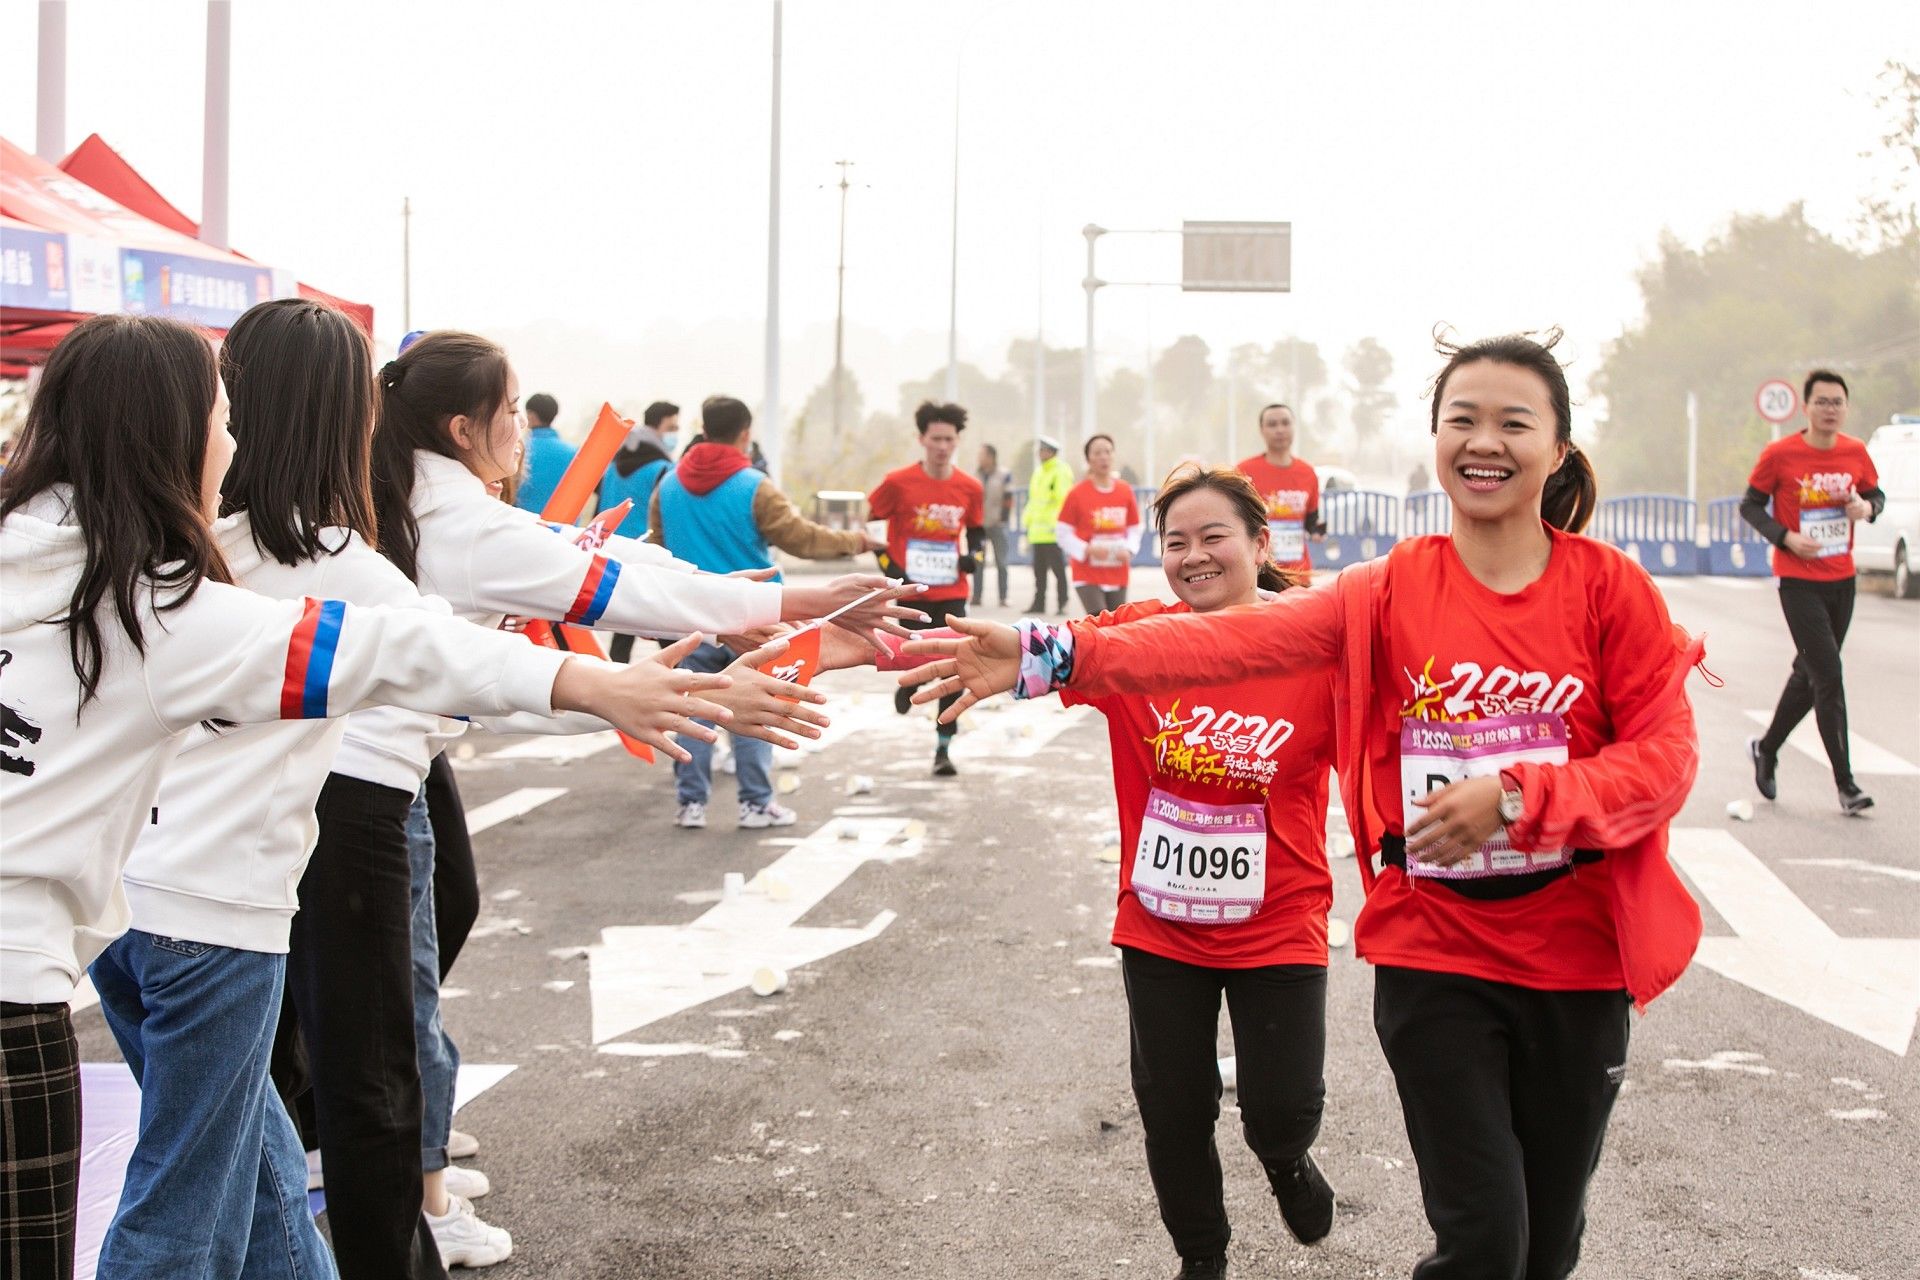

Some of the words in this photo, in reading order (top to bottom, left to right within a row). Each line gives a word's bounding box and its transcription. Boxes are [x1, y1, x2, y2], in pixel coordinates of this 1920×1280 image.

[1766, 390, 1788, 411] 20
[1444, 661, 1584, 716] 2020
[1183, 705, 1294, 758] 2020
[1166, 739, 1227, 776] 湘江
[1226, 770, 1273, 784] MARATHON
[1152, 834, 1250, 880] D1096
